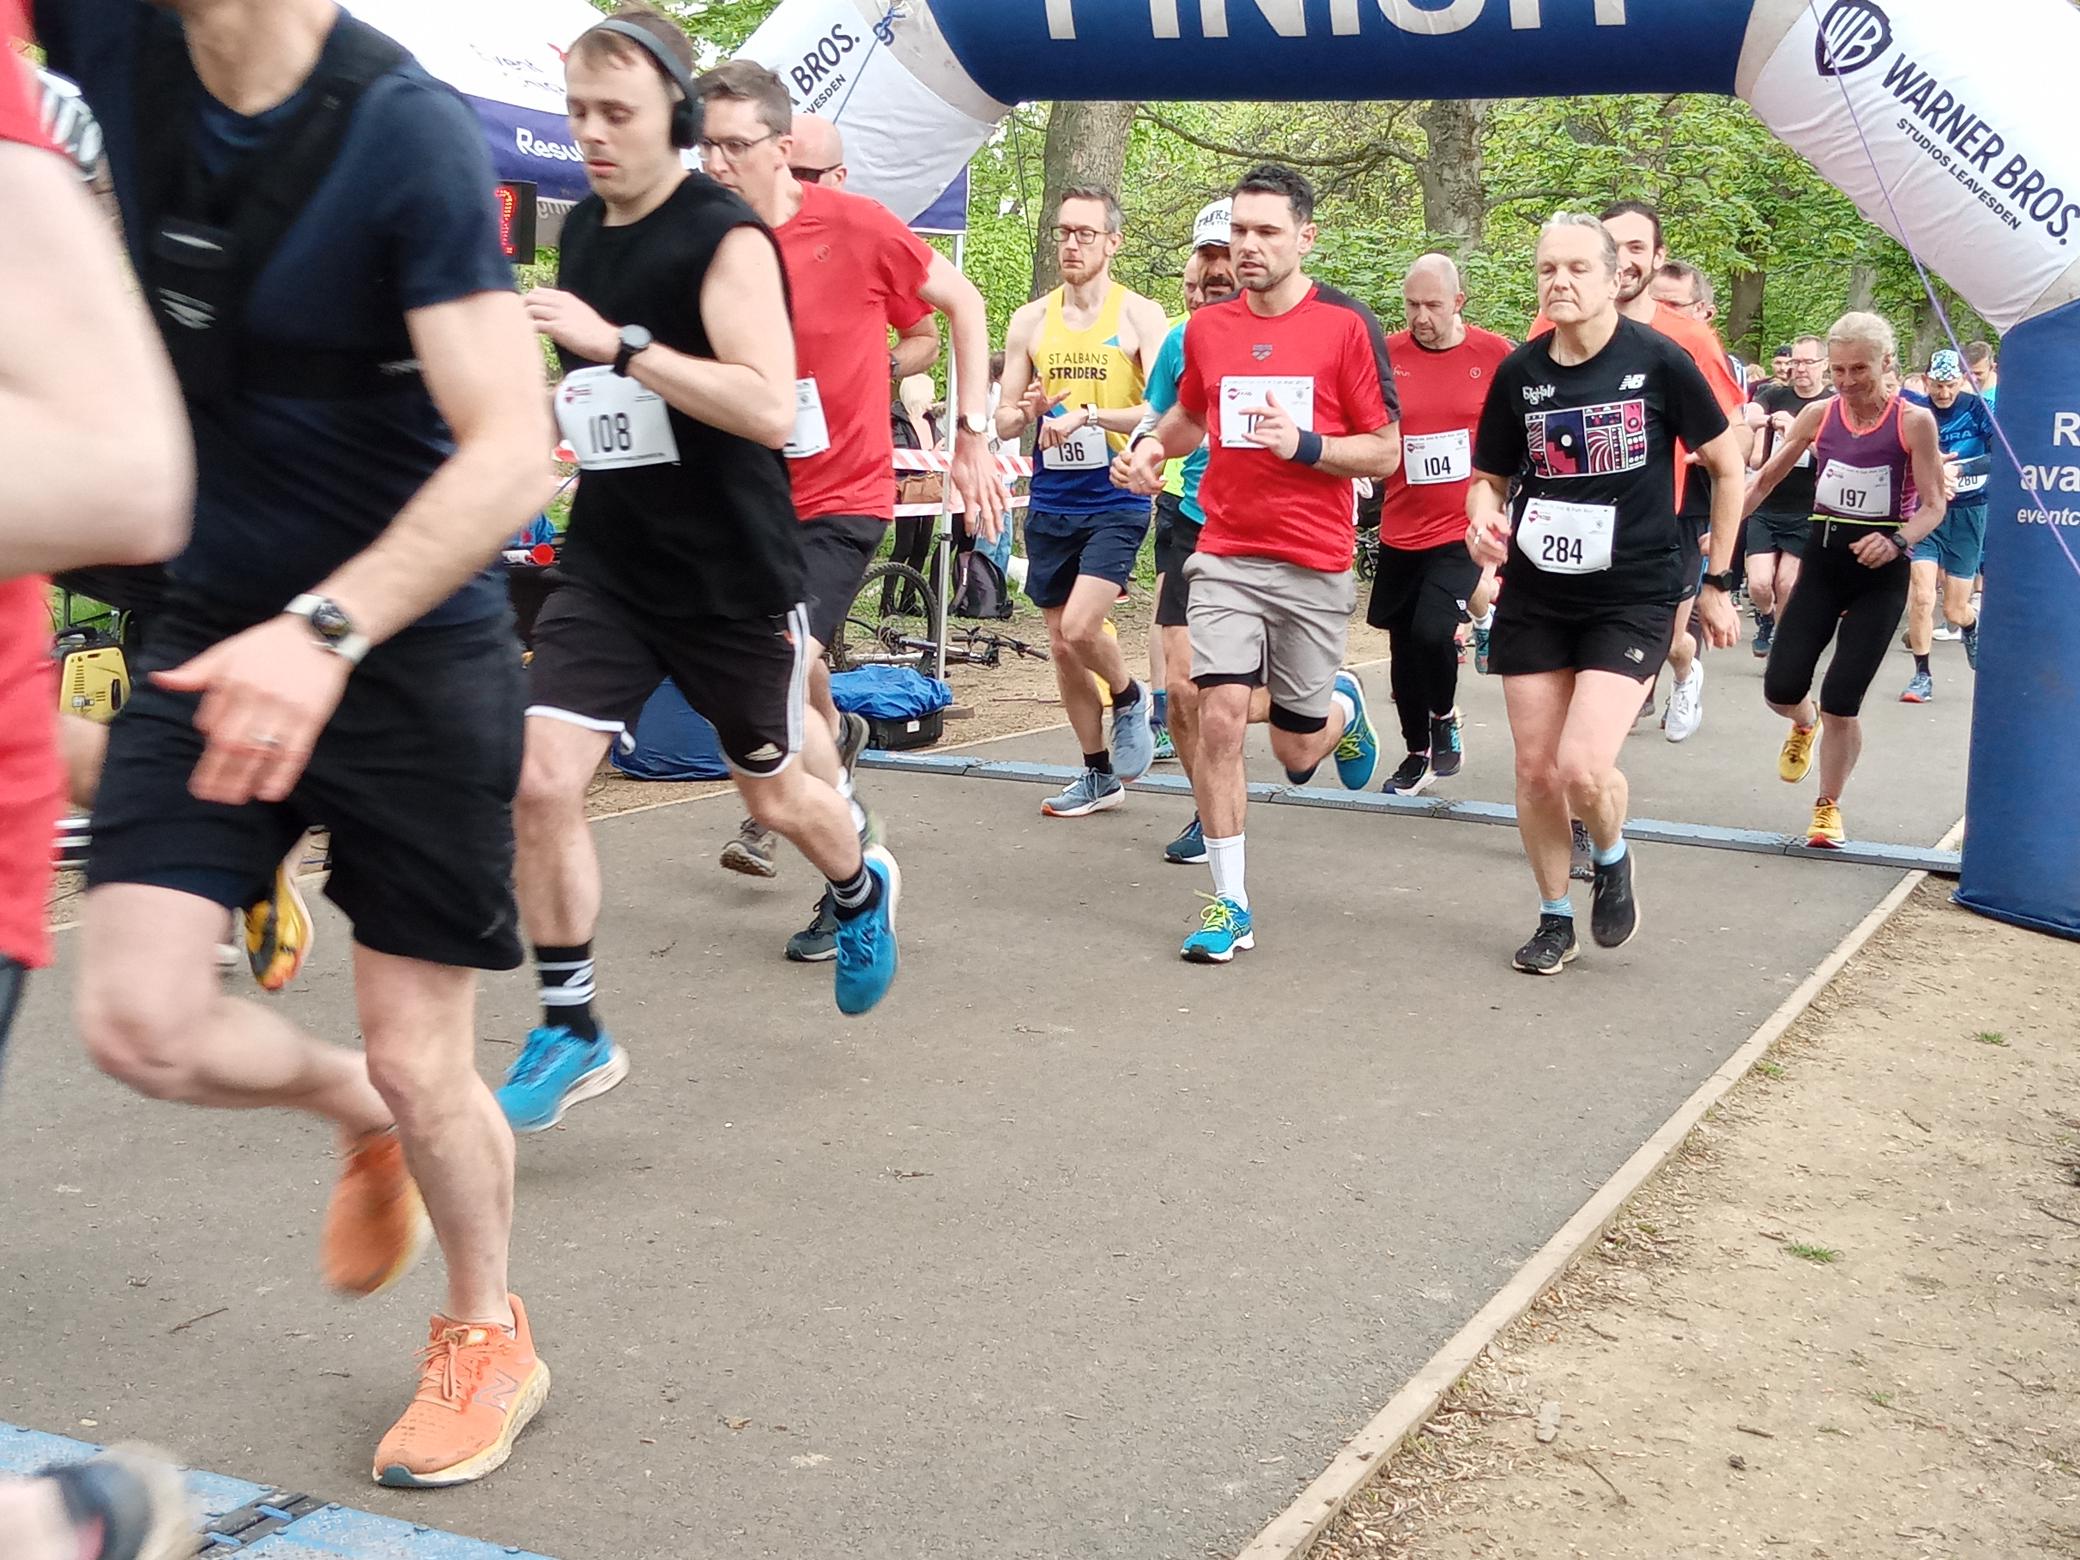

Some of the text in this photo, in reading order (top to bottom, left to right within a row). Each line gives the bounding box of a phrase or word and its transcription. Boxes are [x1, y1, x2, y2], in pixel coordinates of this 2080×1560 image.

[789, 23, 861, 97] BROS.
[1881, 52, 2080, 246] WARNER BROS.
[1896, 117, 2022, 231] STUDIOS LEAVESDEN
[1048, 352, 1109, 365] ST ALBANS
[1049, 367, 1107, 380] STRIDERS
[588, 412, 632, 454] 108
[1058, 442, 1085, 462] 136
[1423, 455, 1452, 477] 104
[1839, 487, 1868, 509] 197
[1541, 534, 1584, 565] 284
